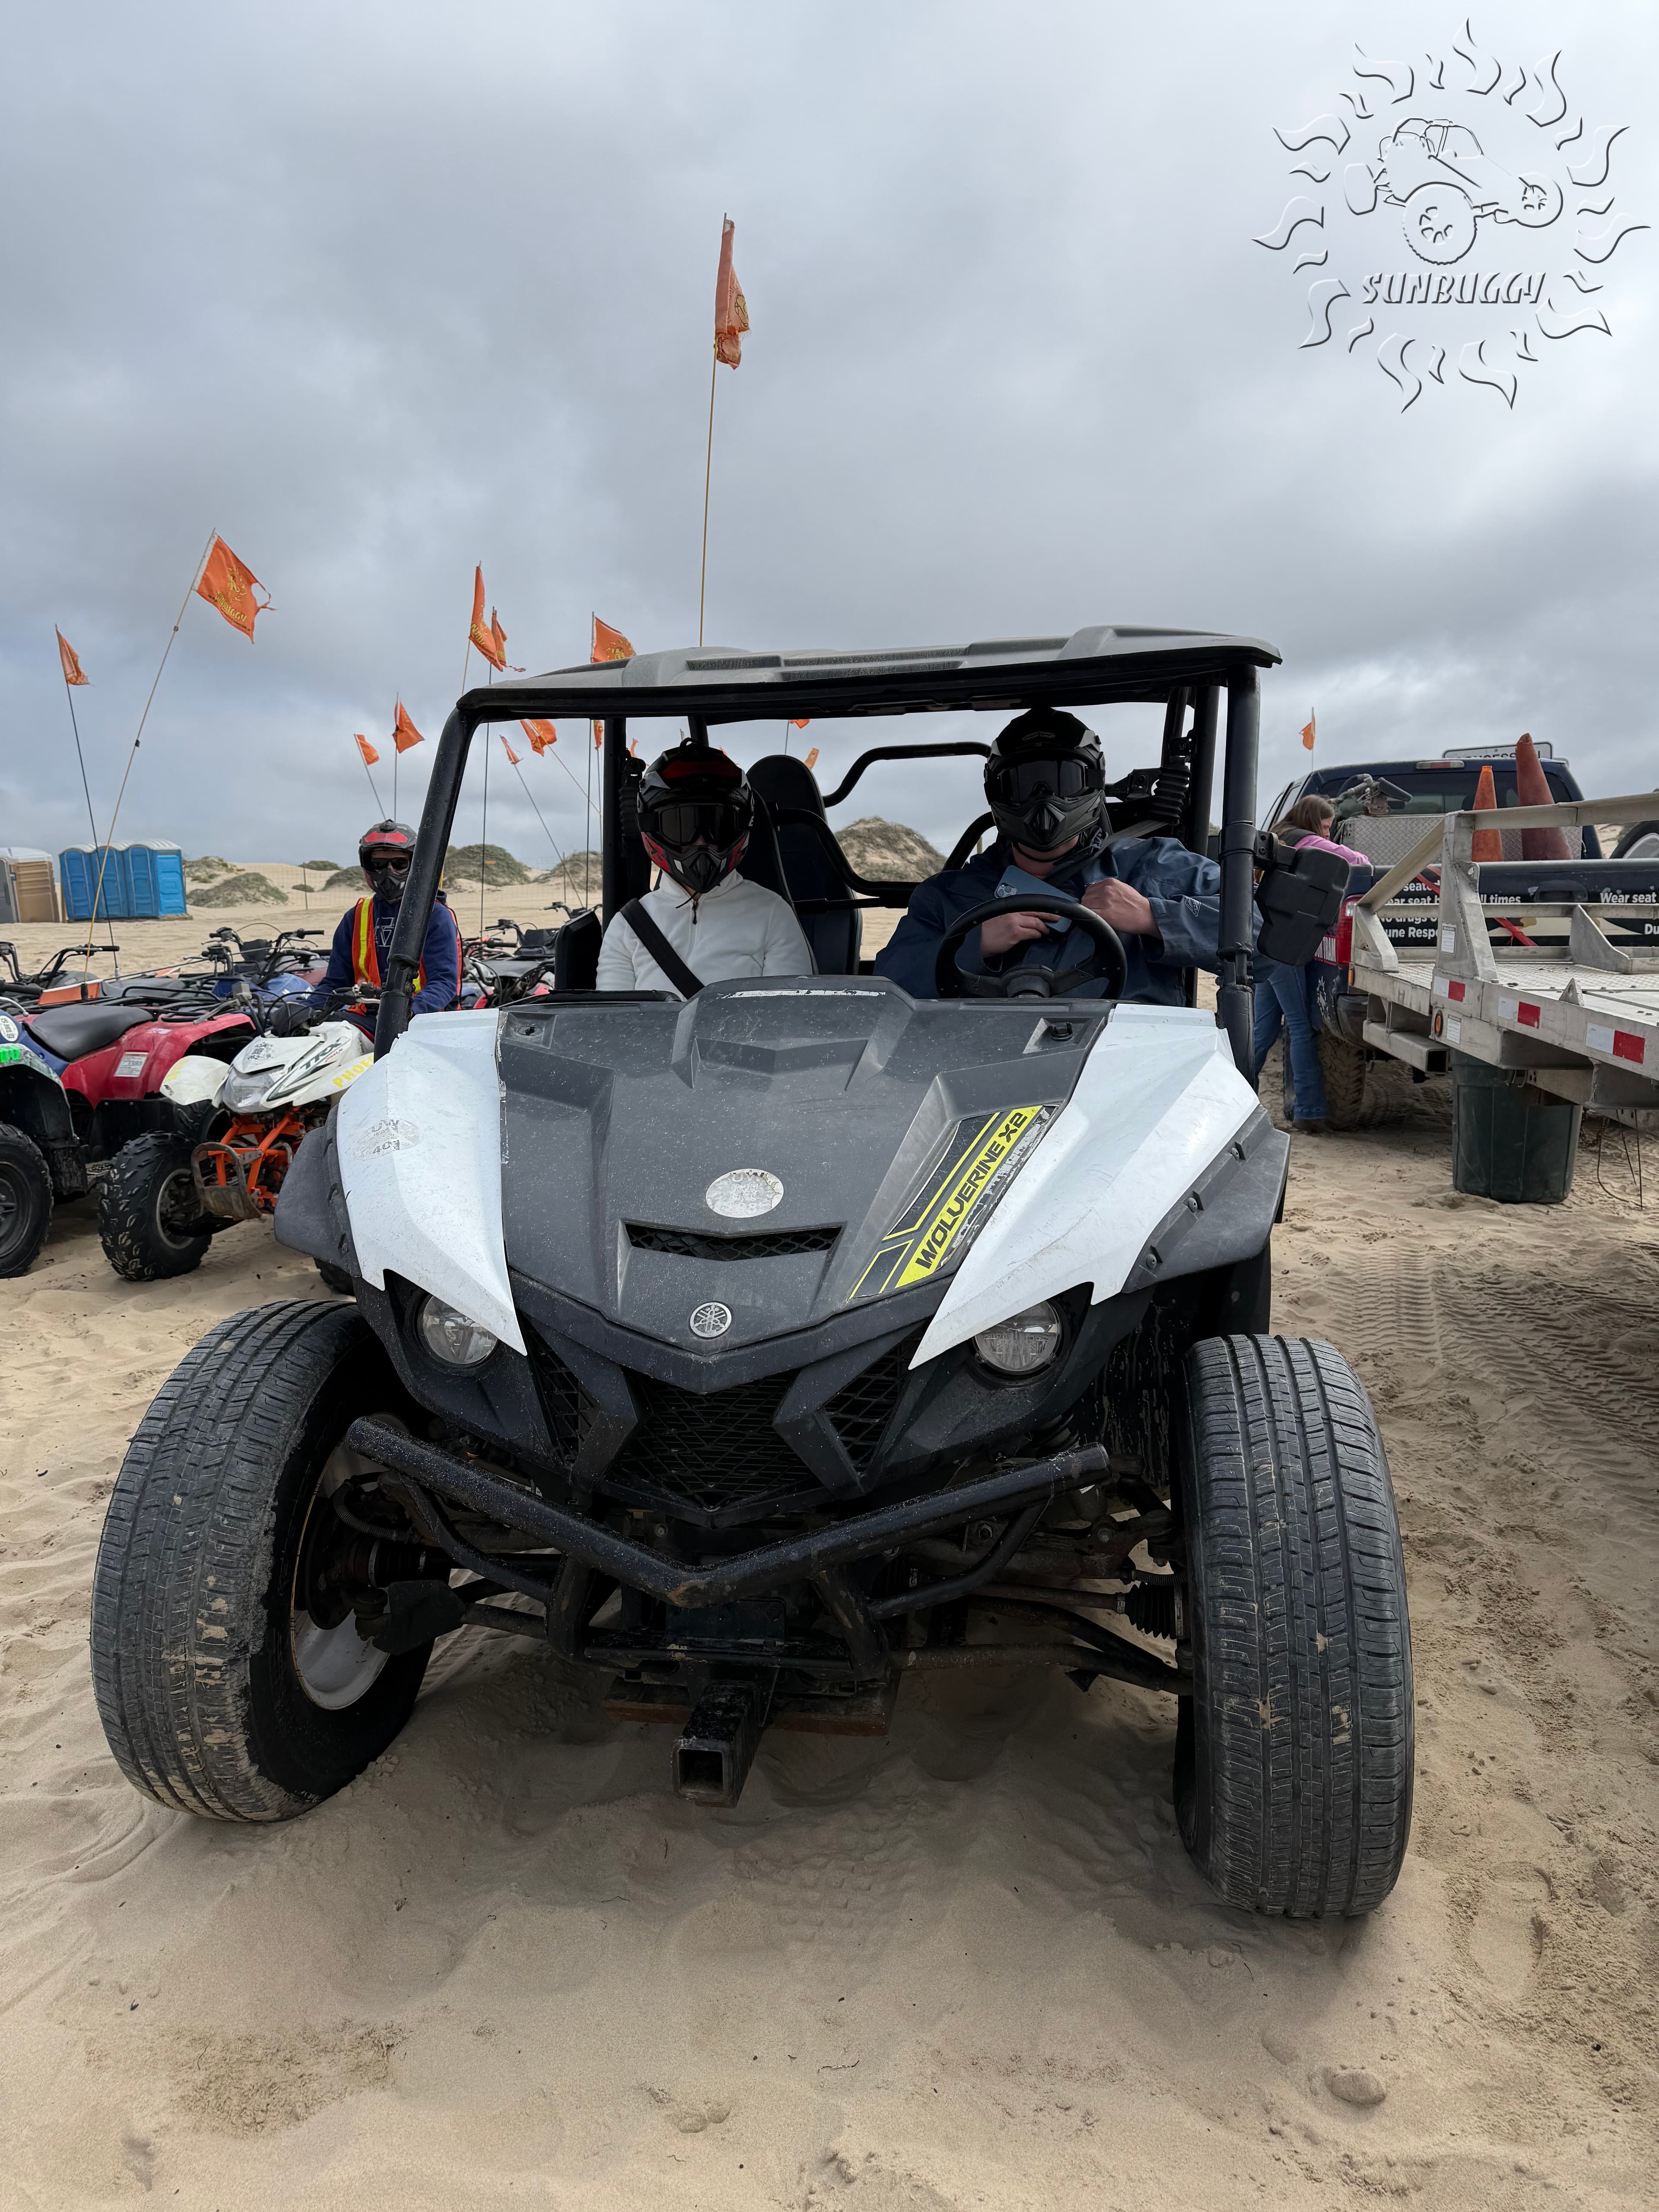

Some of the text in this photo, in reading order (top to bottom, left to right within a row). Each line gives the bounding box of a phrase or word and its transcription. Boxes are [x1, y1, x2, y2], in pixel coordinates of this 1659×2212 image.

[1403, 880, 1440, 891] seat
[1408, 896, 1431, 904] seat
[1490, 894, 1521, 903] times
[1600, 892, 1657, 903] Wear seat
[1386, 928, 1405, 938] une
[300, 1037, 342, 1070] TRX
[915, 1112, 1027, 1270] WOLVERINE X2
